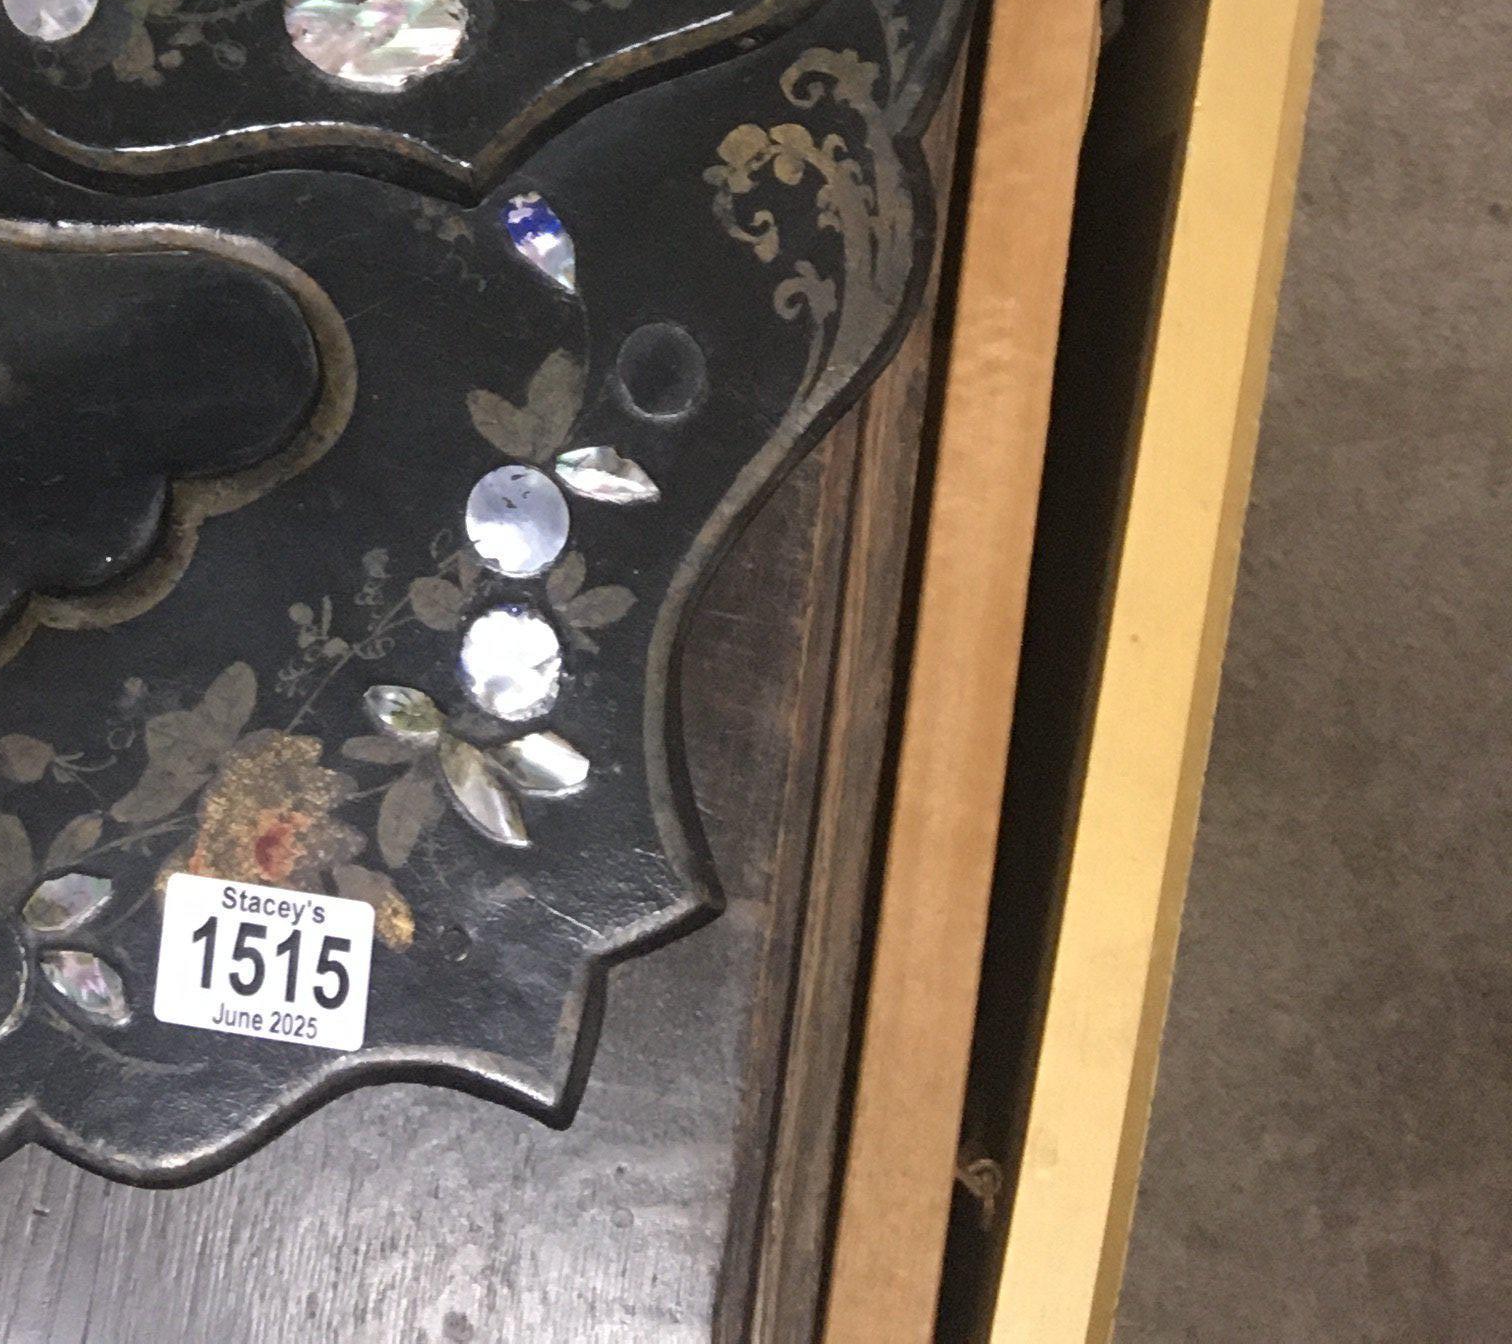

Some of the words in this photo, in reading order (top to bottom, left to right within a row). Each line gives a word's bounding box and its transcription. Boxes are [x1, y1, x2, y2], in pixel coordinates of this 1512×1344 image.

[221, 886, 326, 926] Stacey's
[192, 915, 352, 1010] 1515
[212, 1003, 264, 1031] June
[268, 1010, 318, 1039] 2025
